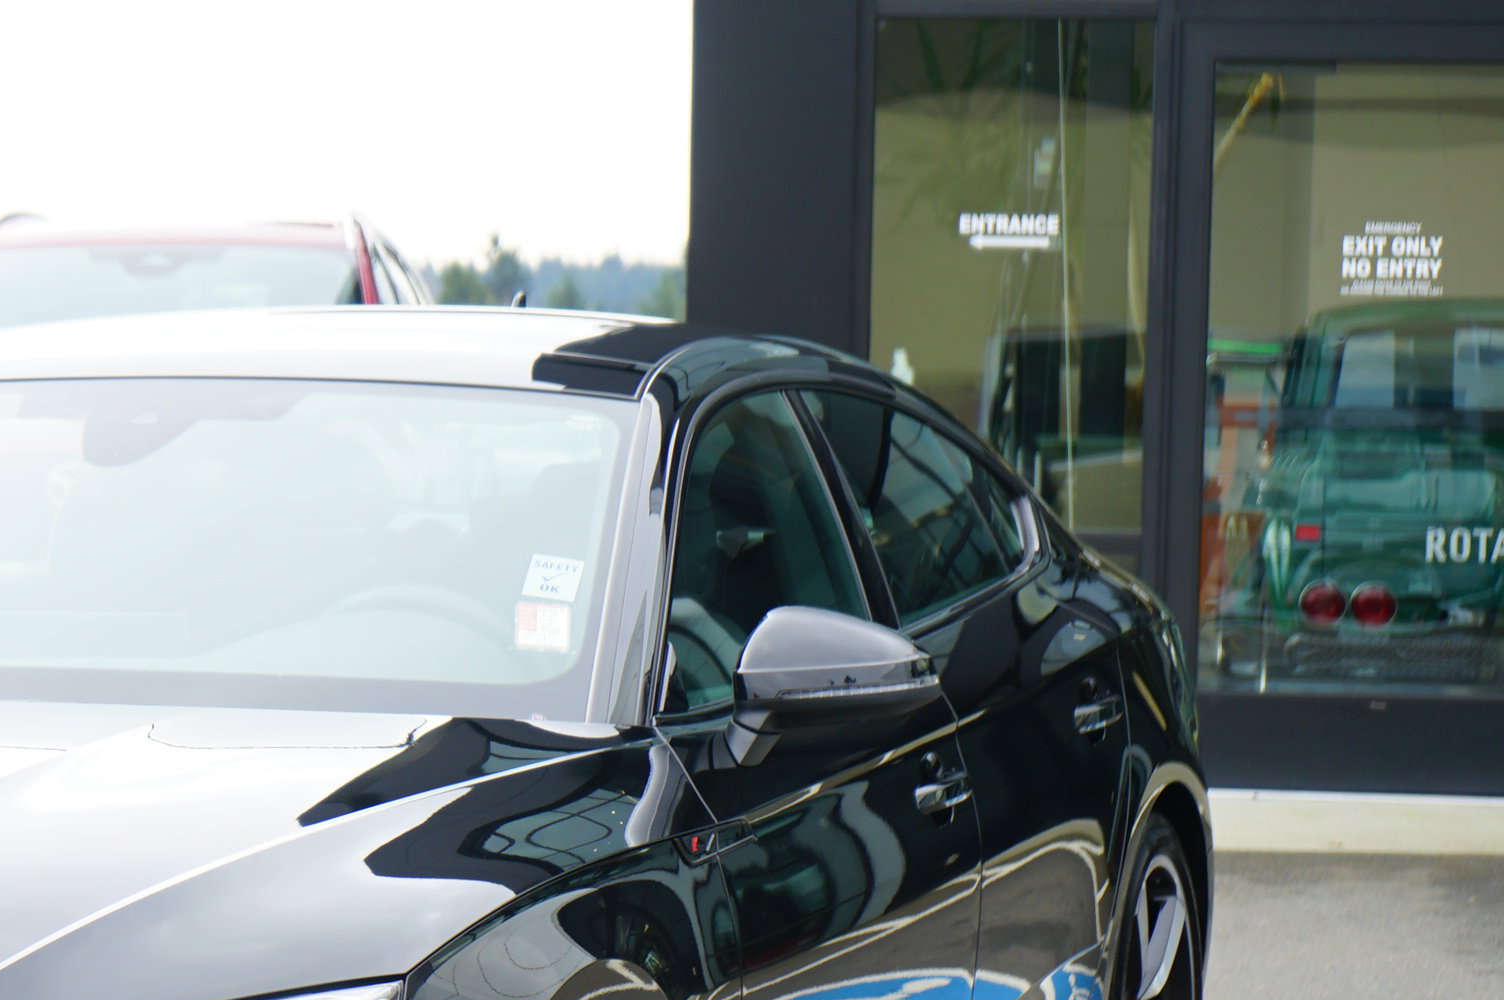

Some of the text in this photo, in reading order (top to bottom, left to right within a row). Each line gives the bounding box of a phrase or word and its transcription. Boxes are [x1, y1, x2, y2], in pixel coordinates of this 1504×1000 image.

[959, 212, 1060, 235] ENTRANCE
[1365, 221, 1422, 234] EMERGENCY
[1342, 235, 1443, 257] EXIT ONLY
[1341, 257, 1442, 279] NO ENTRY
[535, 560, 579, 573] SAFETY
[539, 584, 559, 593] OK
